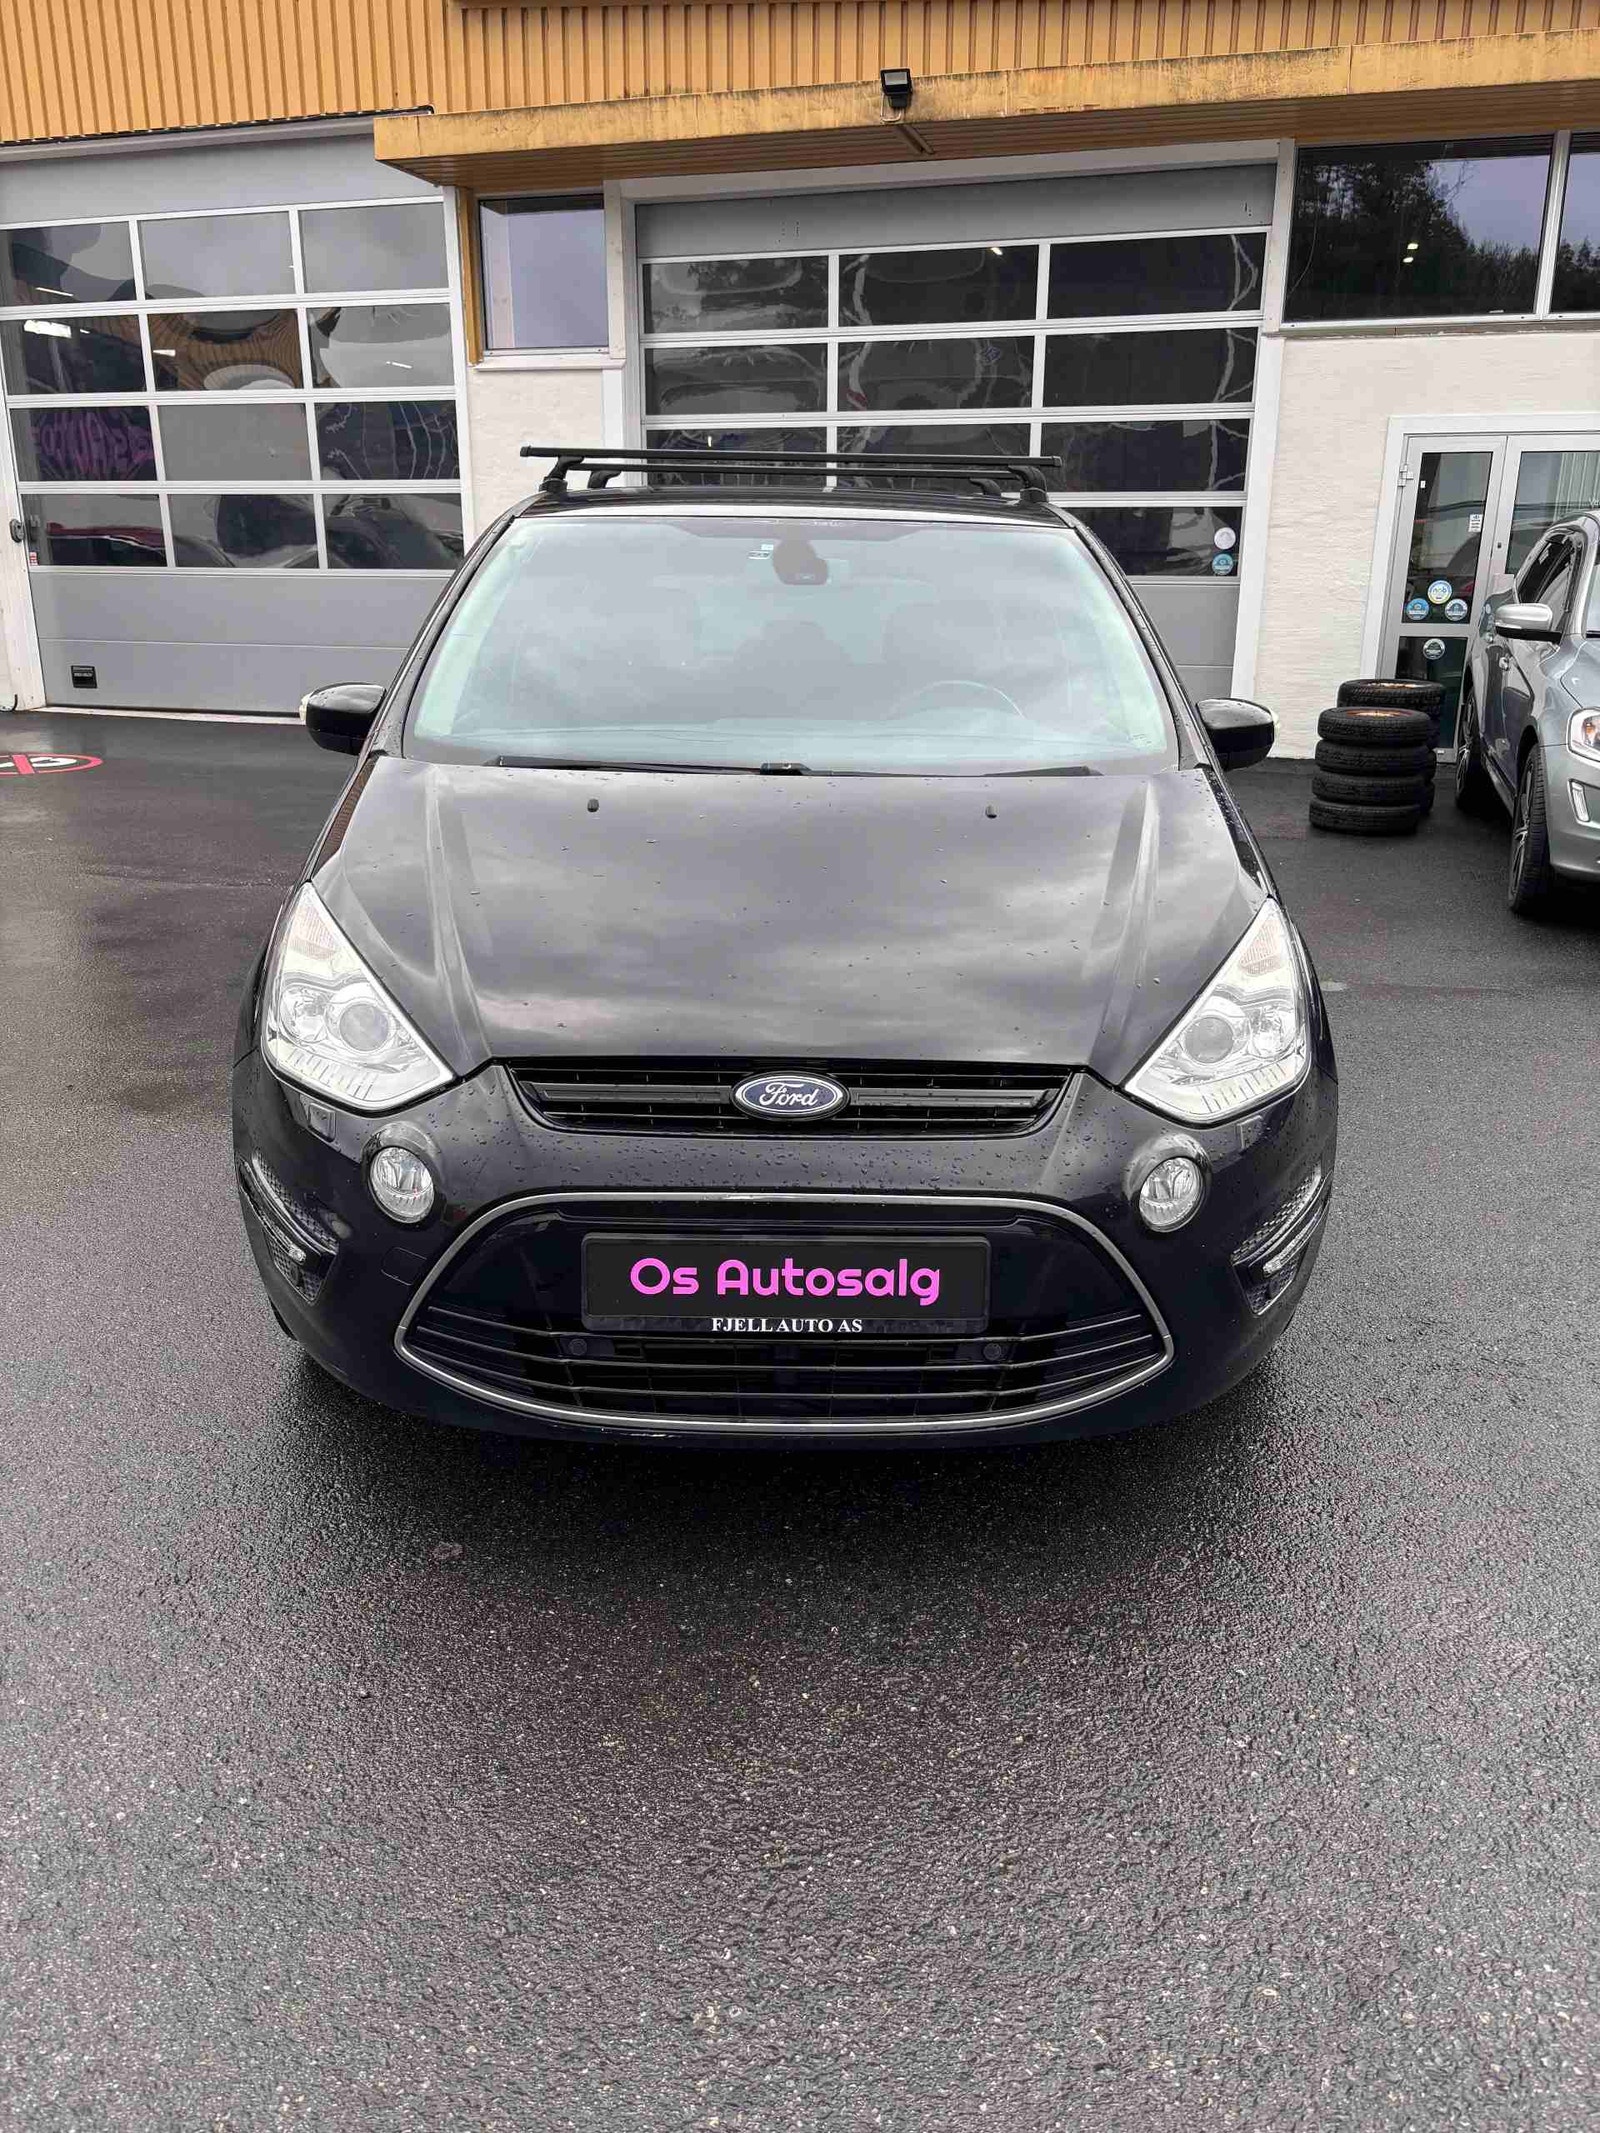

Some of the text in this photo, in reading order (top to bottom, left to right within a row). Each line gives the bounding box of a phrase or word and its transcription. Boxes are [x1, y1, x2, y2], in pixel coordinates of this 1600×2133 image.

[759, 1082, 819, 1105] Ford
[629, 1257, 940, 1306] Os Autosalg
[711, 1316, 863, 1333] FJELL AUTO AS
